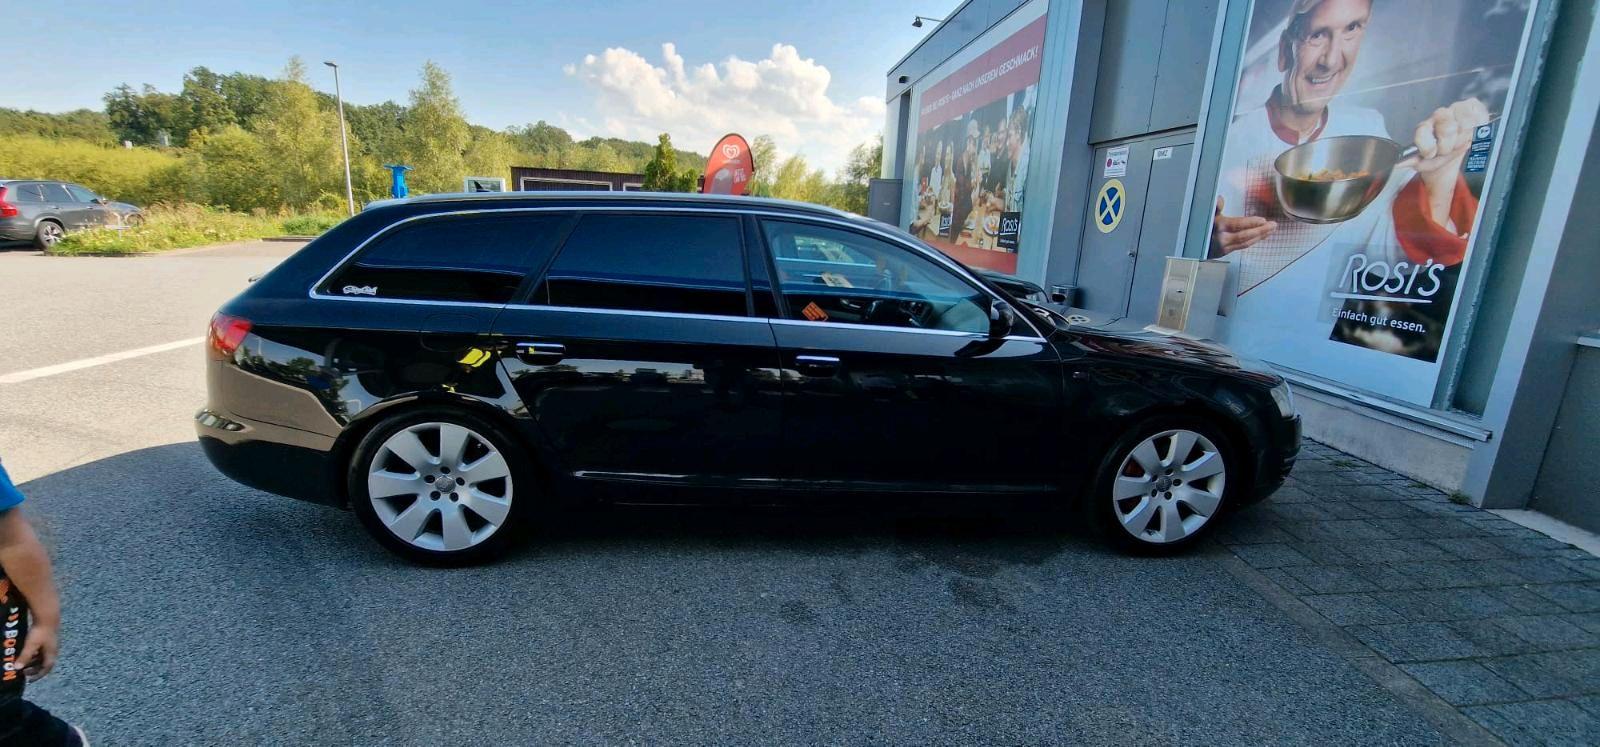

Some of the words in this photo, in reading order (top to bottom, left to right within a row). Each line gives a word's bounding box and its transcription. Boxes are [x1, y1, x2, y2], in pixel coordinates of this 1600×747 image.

[999, 45, 1039, 76] GESCHMACK!
[1339, 253, 1445, 297] ROSI'S
[1331, 307, 1367, 323] Einfach
[1369, 315, 1388, 326] gut
[1390, 319, 1426, 333] essen.
[2, 629, 19, 680] BOSTON
